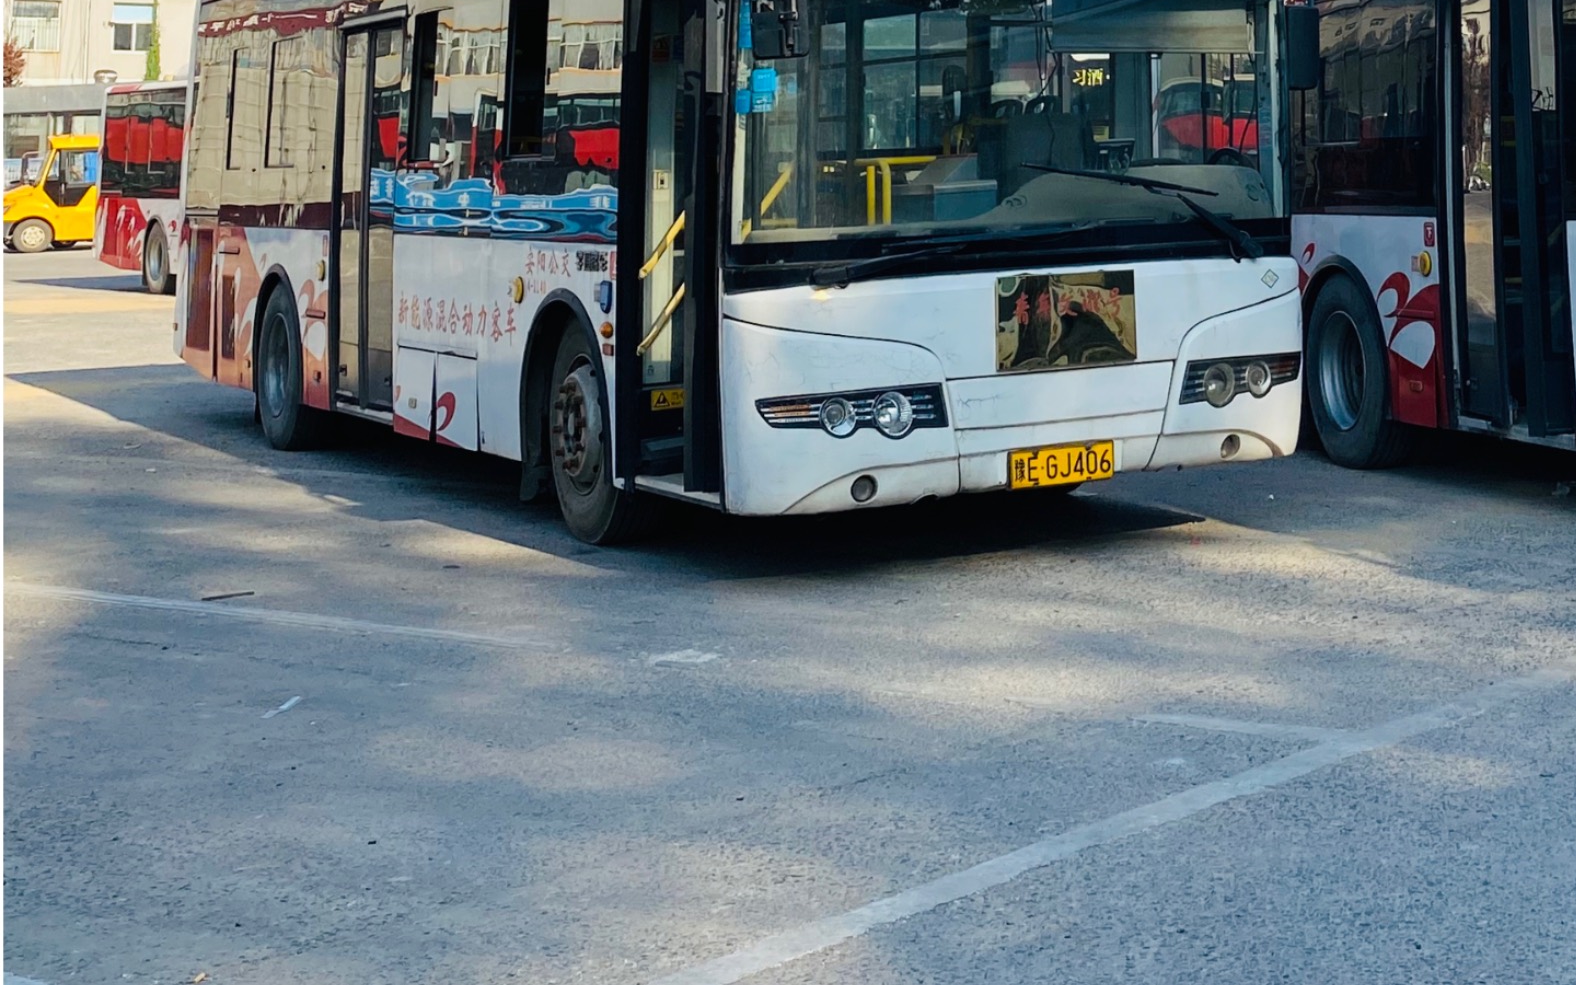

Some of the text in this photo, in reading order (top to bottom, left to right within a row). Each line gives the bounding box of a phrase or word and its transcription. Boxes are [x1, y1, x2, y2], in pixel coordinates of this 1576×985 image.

[525, 245, 571, 277] 安阳公交
[398, 291, 517, 347] 新能源混合动力客车
